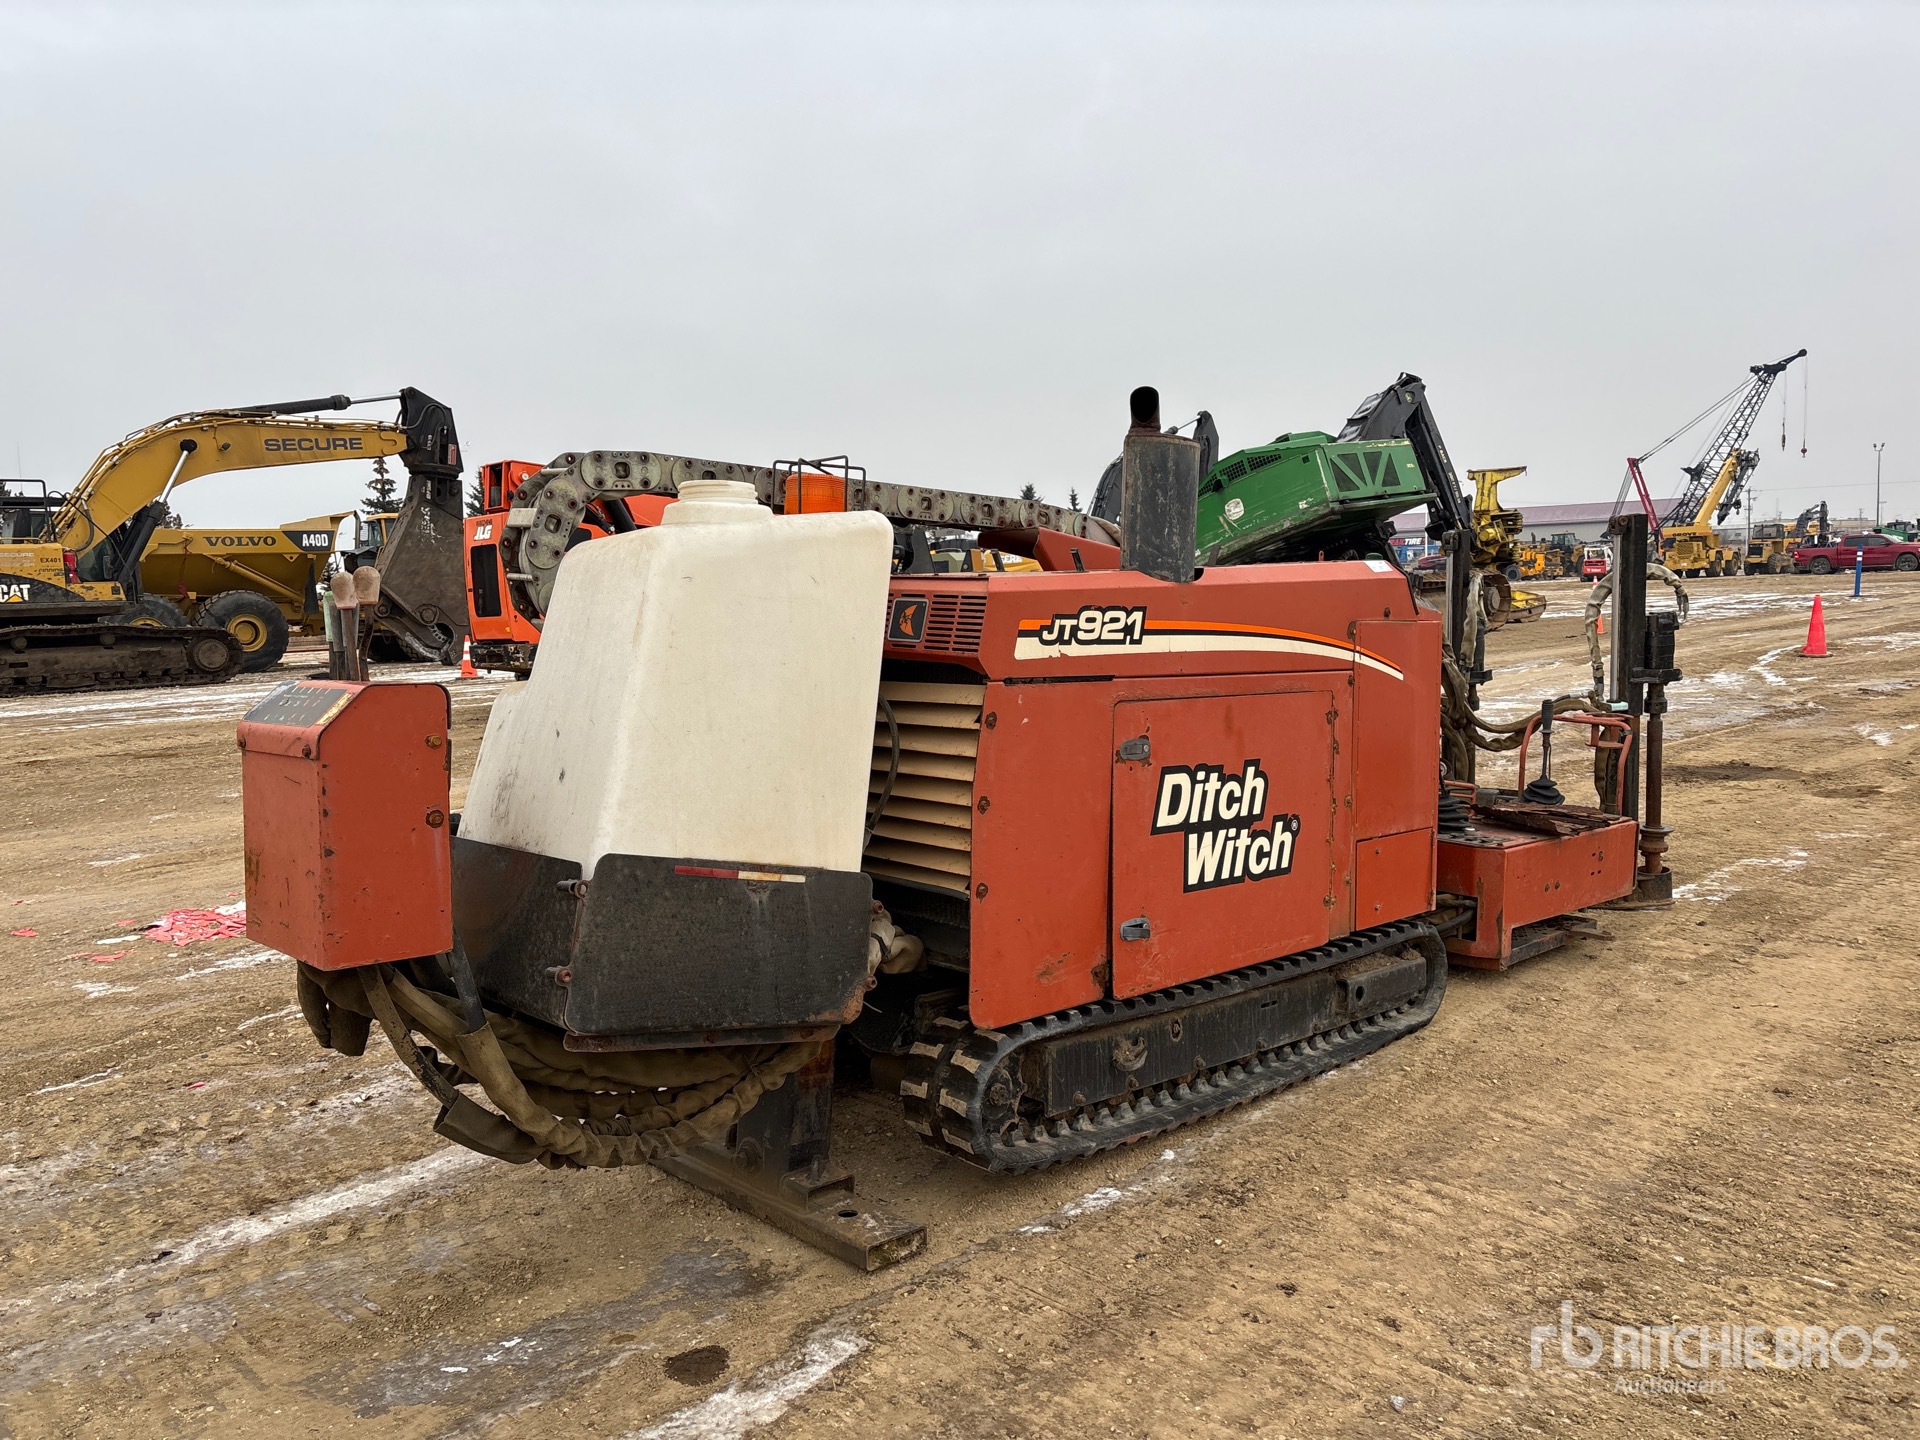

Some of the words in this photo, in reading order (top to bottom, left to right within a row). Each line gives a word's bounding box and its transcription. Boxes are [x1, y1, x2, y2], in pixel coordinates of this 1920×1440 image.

[264, 437, 364, 452] SECURE
[302, 533, 329, 548] A40D
[473, 524, 493, 541] JLG
[203, 536, 277, 547] VOLVO
[1404, 537, 1422, 546] TIRE
[0, 584, 31, 603] CAT
[1042, 610, 1143, 641] JT921
[1156, 766, 1265, 828] Ditch
